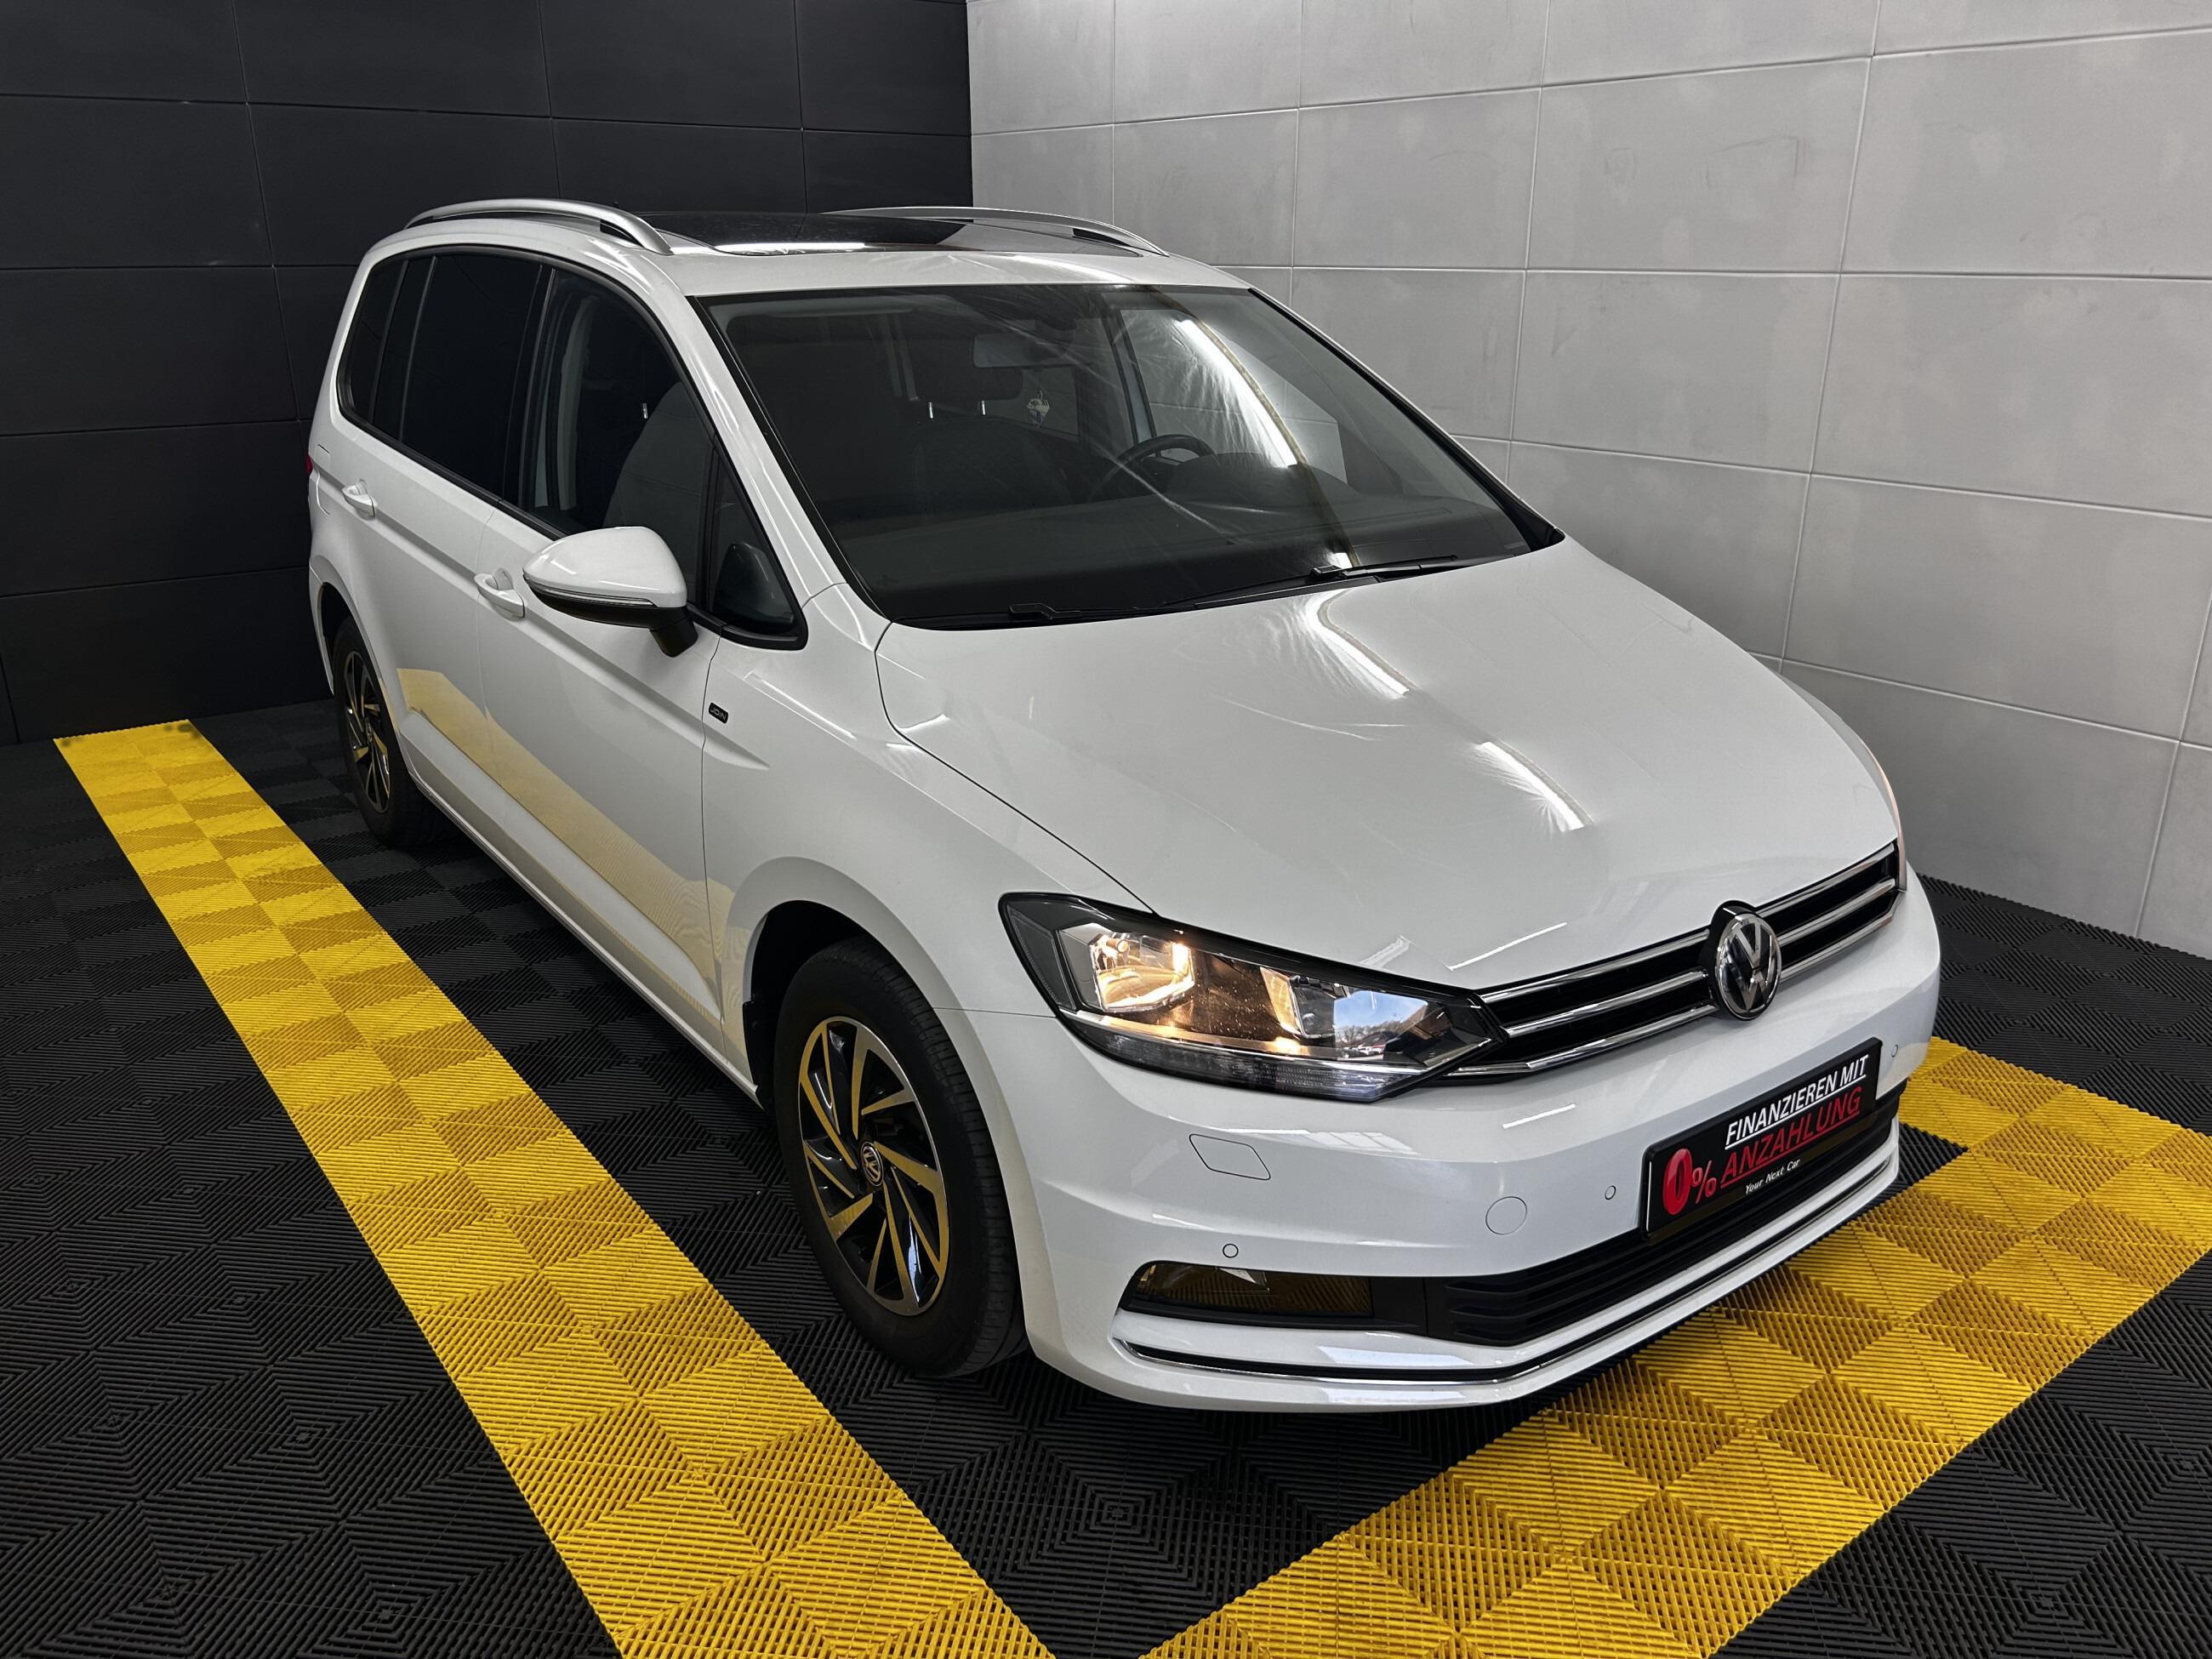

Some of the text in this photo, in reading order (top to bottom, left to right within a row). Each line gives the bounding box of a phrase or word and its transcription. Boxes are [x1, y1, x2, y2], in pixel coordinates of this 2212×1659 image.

[1725, 1054, 1869, 1148] FINANZIEREN MIT
[1662, 1086, 1863, 1215] 0% ANZAHLUNG
[1745, 1158, 1801, 1194] Your Next Car
